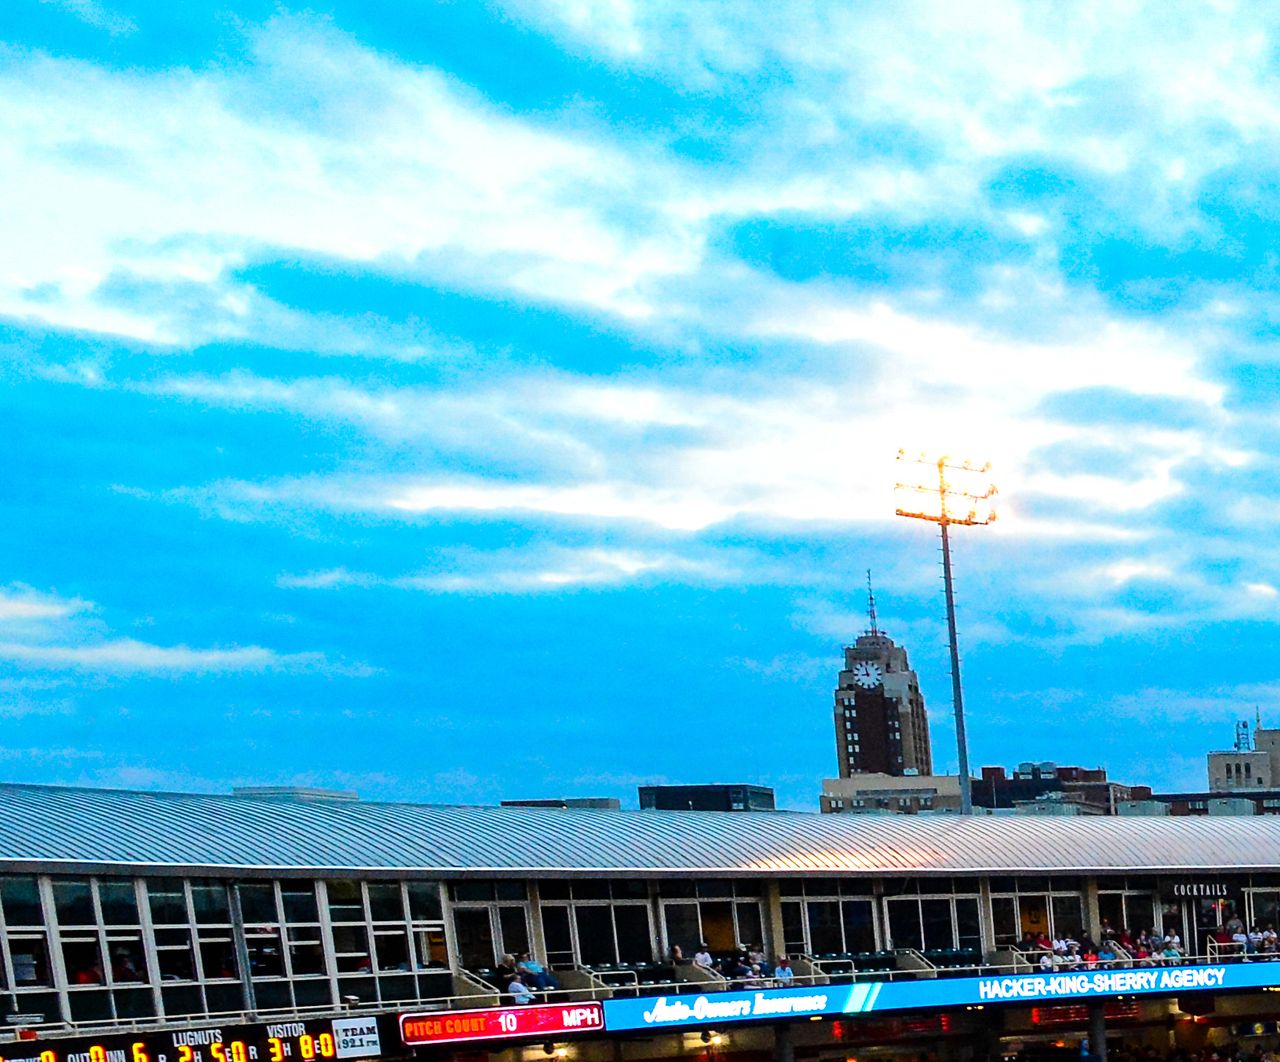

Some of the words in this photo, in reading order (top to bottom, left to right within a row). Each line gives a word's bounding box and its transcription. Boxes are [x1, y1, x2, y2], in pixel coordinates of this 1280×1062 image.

[1173, 884, 1228, 896] COCKTAILS
[979, 973, 1158, 999] HACKER-KING-SHERRY
[1160, 968, 1226, 988] AGENCY
[267, 1023, 306, 1038] VISITOR
[405, 1021, 442, 1037] PITCH
[447, 1017, 486, 1036] COUNT
[499, 1014, 517, 1032] 10
[562, 1008, 599, 1027] MPH
[172, 1030, 223, 1047] LUGNUTS
[343, 1026, 376, 1037] TEAM
[249, 1046, 258, 1060] R
[268, 1037, 284, 1062] 3
[283, 1043, 292, 1056] H
[300, 1035, 316, 1059] 8
[319, 1033, 334, 1057] 0
